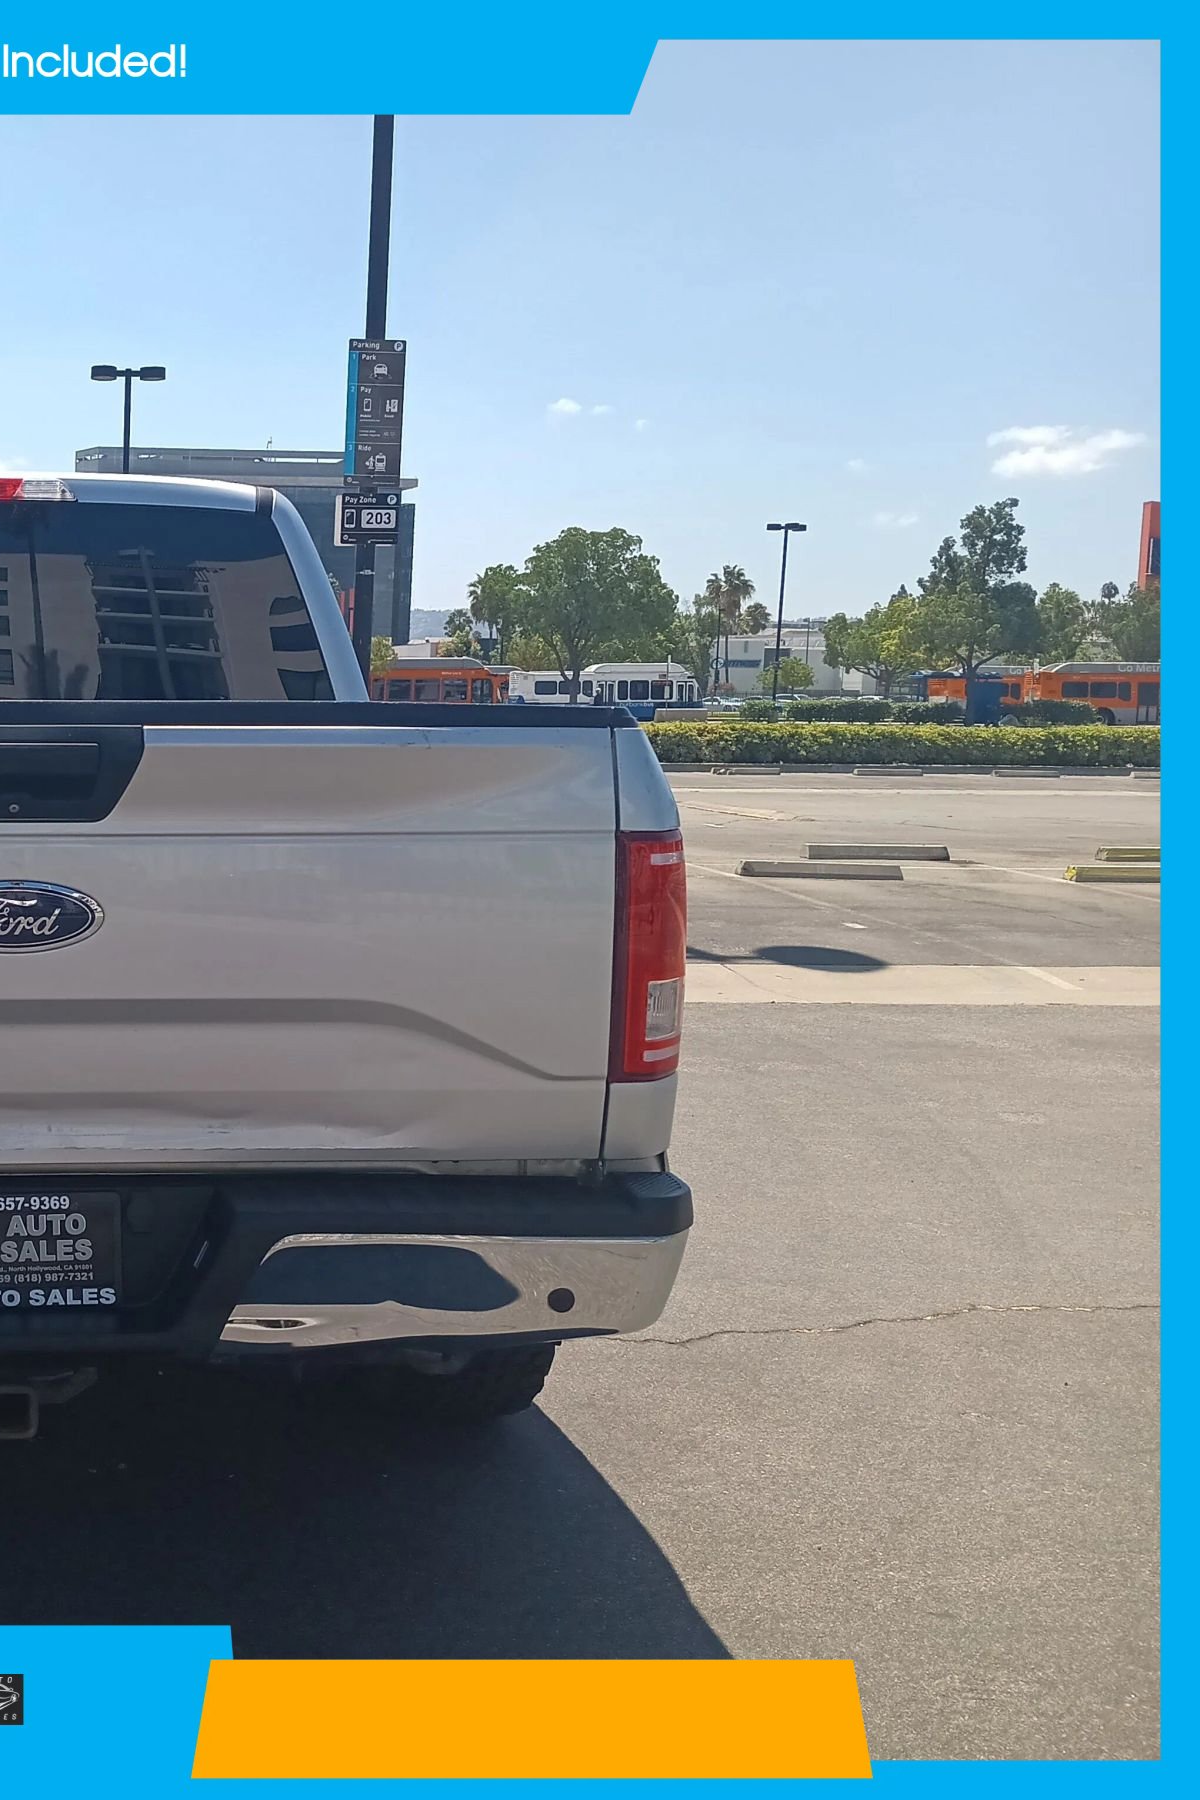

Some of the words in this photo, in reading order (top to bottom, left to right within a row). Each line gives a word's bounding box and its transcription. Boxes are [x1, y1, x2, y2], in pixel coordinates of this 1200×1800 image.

[353, 341, 380, 350] Parking
[360, 386, 371, 394] Pay
[344, 496, 358, 504] Pay
[359, 496, 377, 504] Zone
[366, 512, 392, 525] 203
[6, 1213, 87, 1237] AUTO
[0, 1239, 93, 1263] SALES
[27, 1265, 62, 1273] Hollywood,
[14, 1273, 42, 1284] (818)
[45, 1271, 94, 1282] 987-7321
[29, 1287, 117, 1306] SALES
